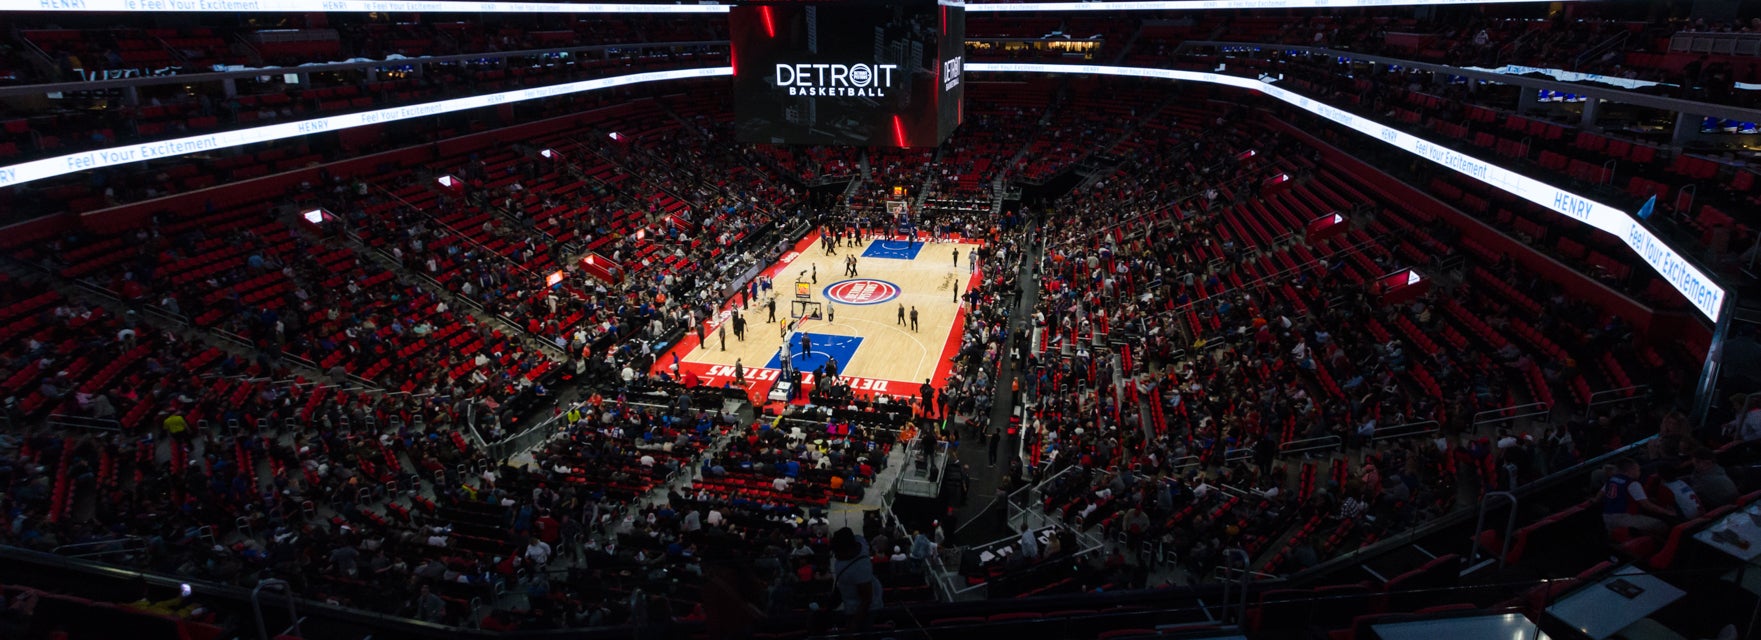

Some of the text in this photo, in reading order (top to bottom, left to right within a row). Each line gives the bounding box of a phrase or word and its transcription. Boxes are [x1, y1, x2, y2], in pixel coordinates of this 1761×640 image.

[141, 0, 167, 10] Feel
[169, 0, 196, 10] Your
[199, 0, 260, 10] Excitement
[776, 63, 897, 87] DETROIT
[789, 87, 884, 97] BASKETBALL
[361, 103, 443, 123] Feel Your Excitement
[298, 120, 329, 133] HENRY
[67, 136, 217, 170] Feel Your Excitement
[1415, 140, 1488, 180] Feel Your Excitement
[1554, 191, 1593, 220] HENRY
[1629, 223, 1718, 316] Feel Your Excitement
